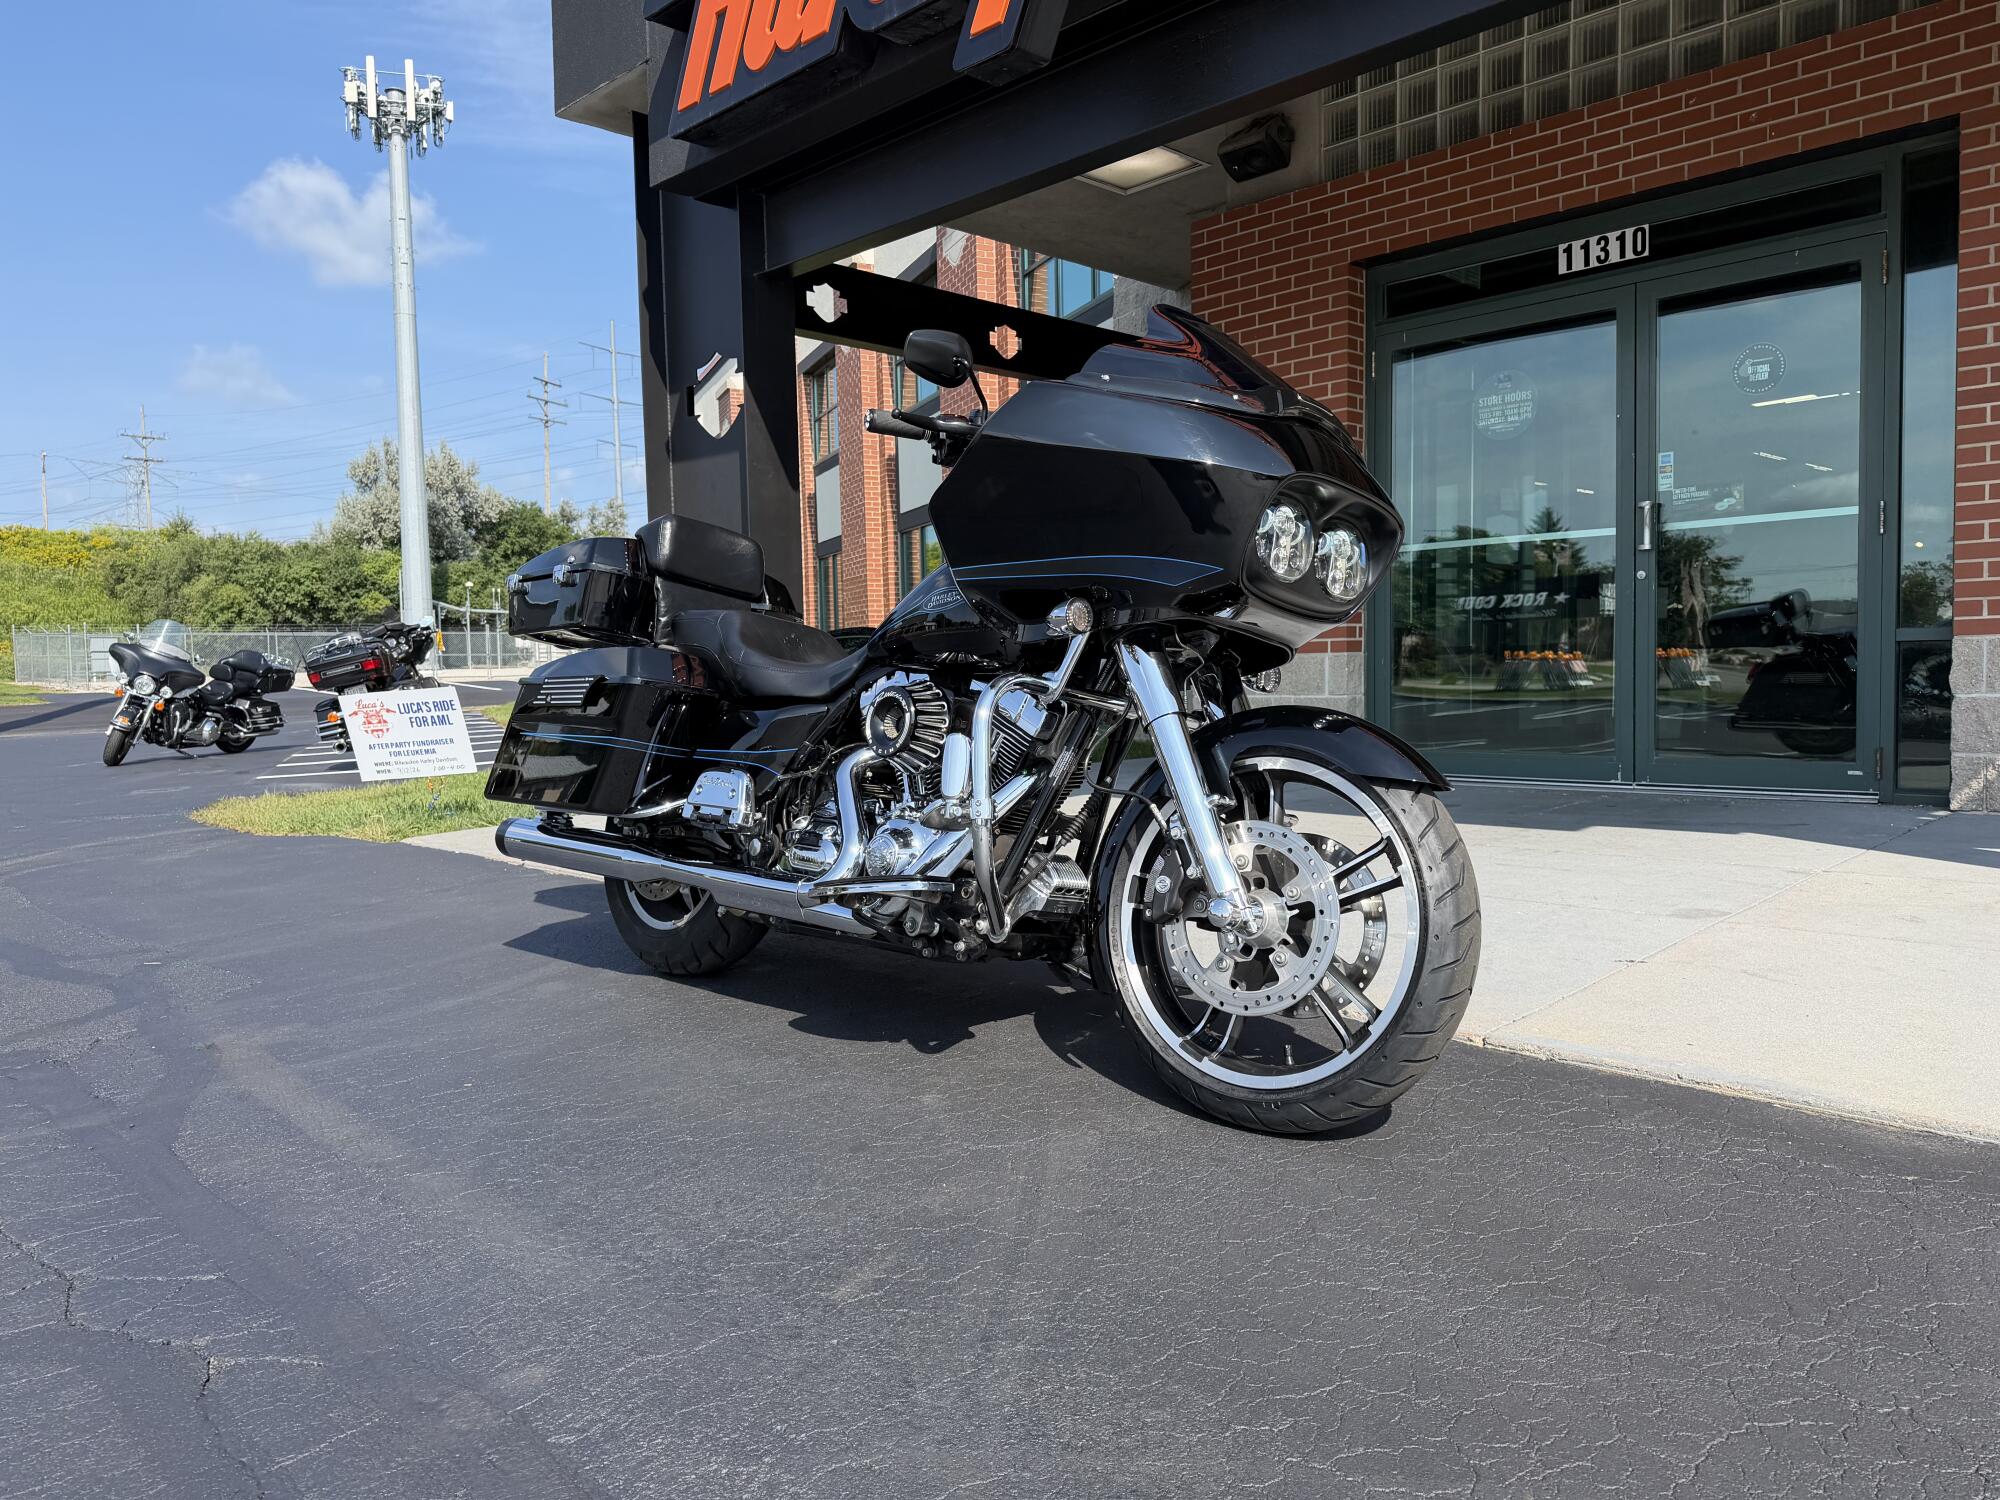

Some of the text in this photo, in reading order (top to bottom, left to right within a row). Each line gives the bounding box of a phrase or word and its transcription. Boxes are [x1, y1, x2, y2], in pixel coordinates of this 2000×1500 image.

[1562, 226, 1647, 272] 11310
[1479, 395, 1502, 407] STORE
[1504, 390, 1532, 403] HOURS
[354, 698, 385, 710] Luca's
[397, 699, 457, 715] LUCA'S RIDE
[409, 714, 454, 728] FOR AML
[368, 738, 455, 751] AFTER PARTY FUNDRAISER
[403, 748, 437, 757] LEUKEMIA
